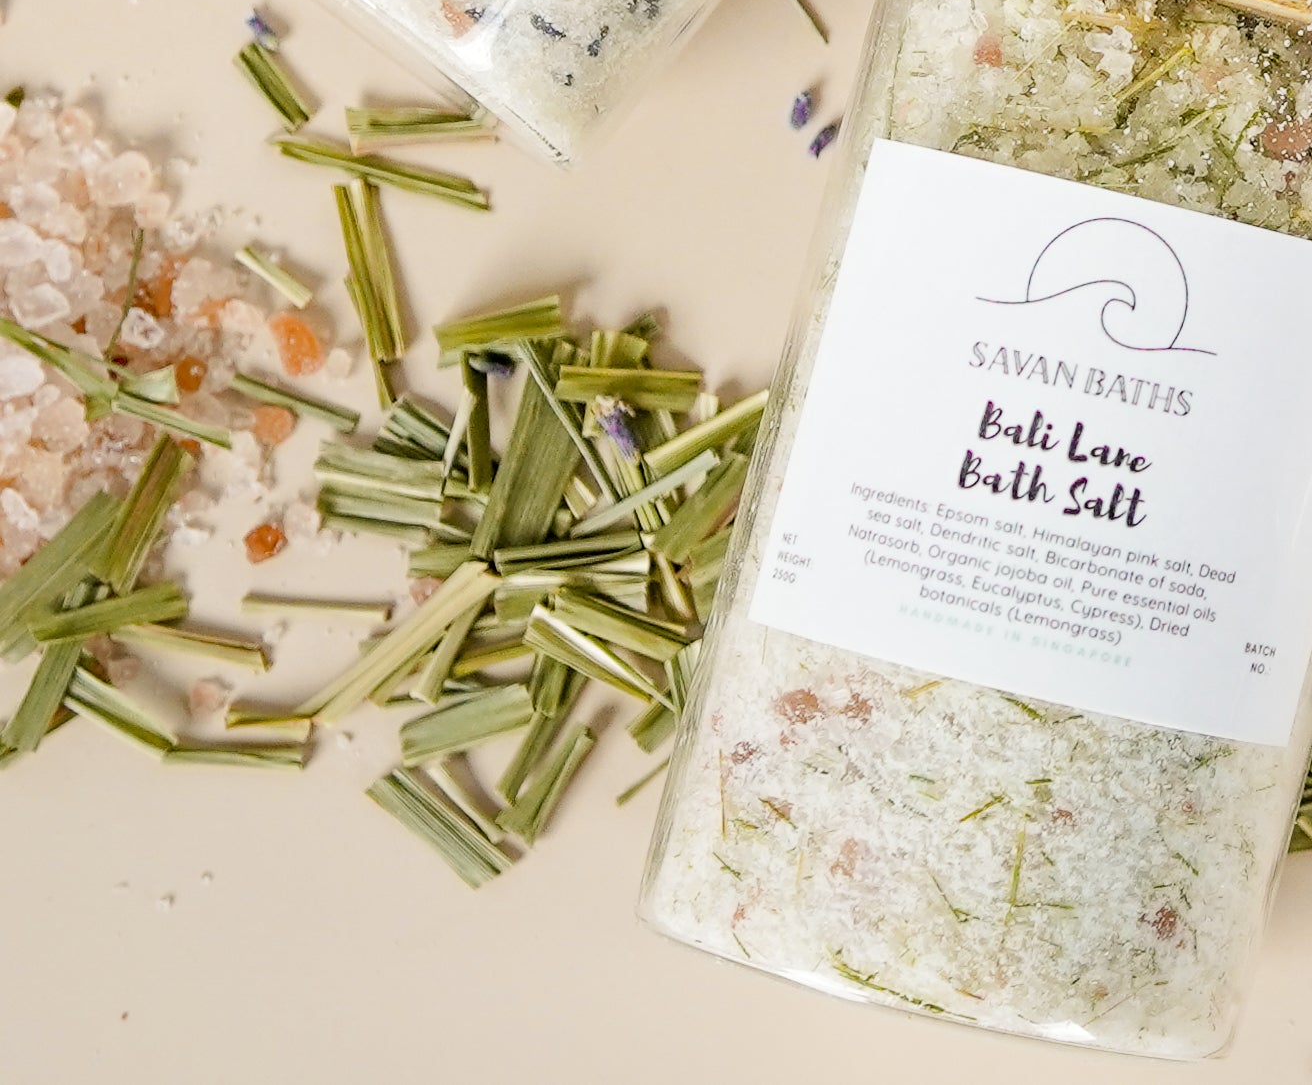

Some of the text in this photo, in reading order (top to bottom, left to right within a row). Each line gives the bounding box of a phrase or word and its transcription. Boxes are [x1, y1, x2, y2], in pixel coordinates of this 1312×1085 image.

[968, 340, 1194, 417] SAVAN BATHS
[977, 399, 1153, 474] Bali Lane
[957, 448, 1148, 529] Bath Salt
[782, 532, 798, 545] NET
[867, 509, 892, 525] sea
[929, 522, 1001, 552] Dendritic
[1044, 549, 1144, 585] Bicarbonate
[1148, 575, 1166, 589] of
[936, 502, 990, 527] Epsom
[1032, 527, 1122, 559] Himalayan
[1125, 551, 1159, 567] pink
[1198, 563, 1237, 584] Dead
[919, 584, 1122, 647] botanicals (Lemongrass)
[927, 544, 991, 572] Organic
[994, 564, 1049, 585] jojoba
[1080, 579, 1118, 601] Pure
[1122, 593, 1191, 616] essential
[1192, 607, 1217, 623] oils
[897, 603, 1133, 668] HANDMADE IN SINGAPORE
[1149, 616, 1191, 638] Dried
[1244, 642, 1277, 657] BATCH
